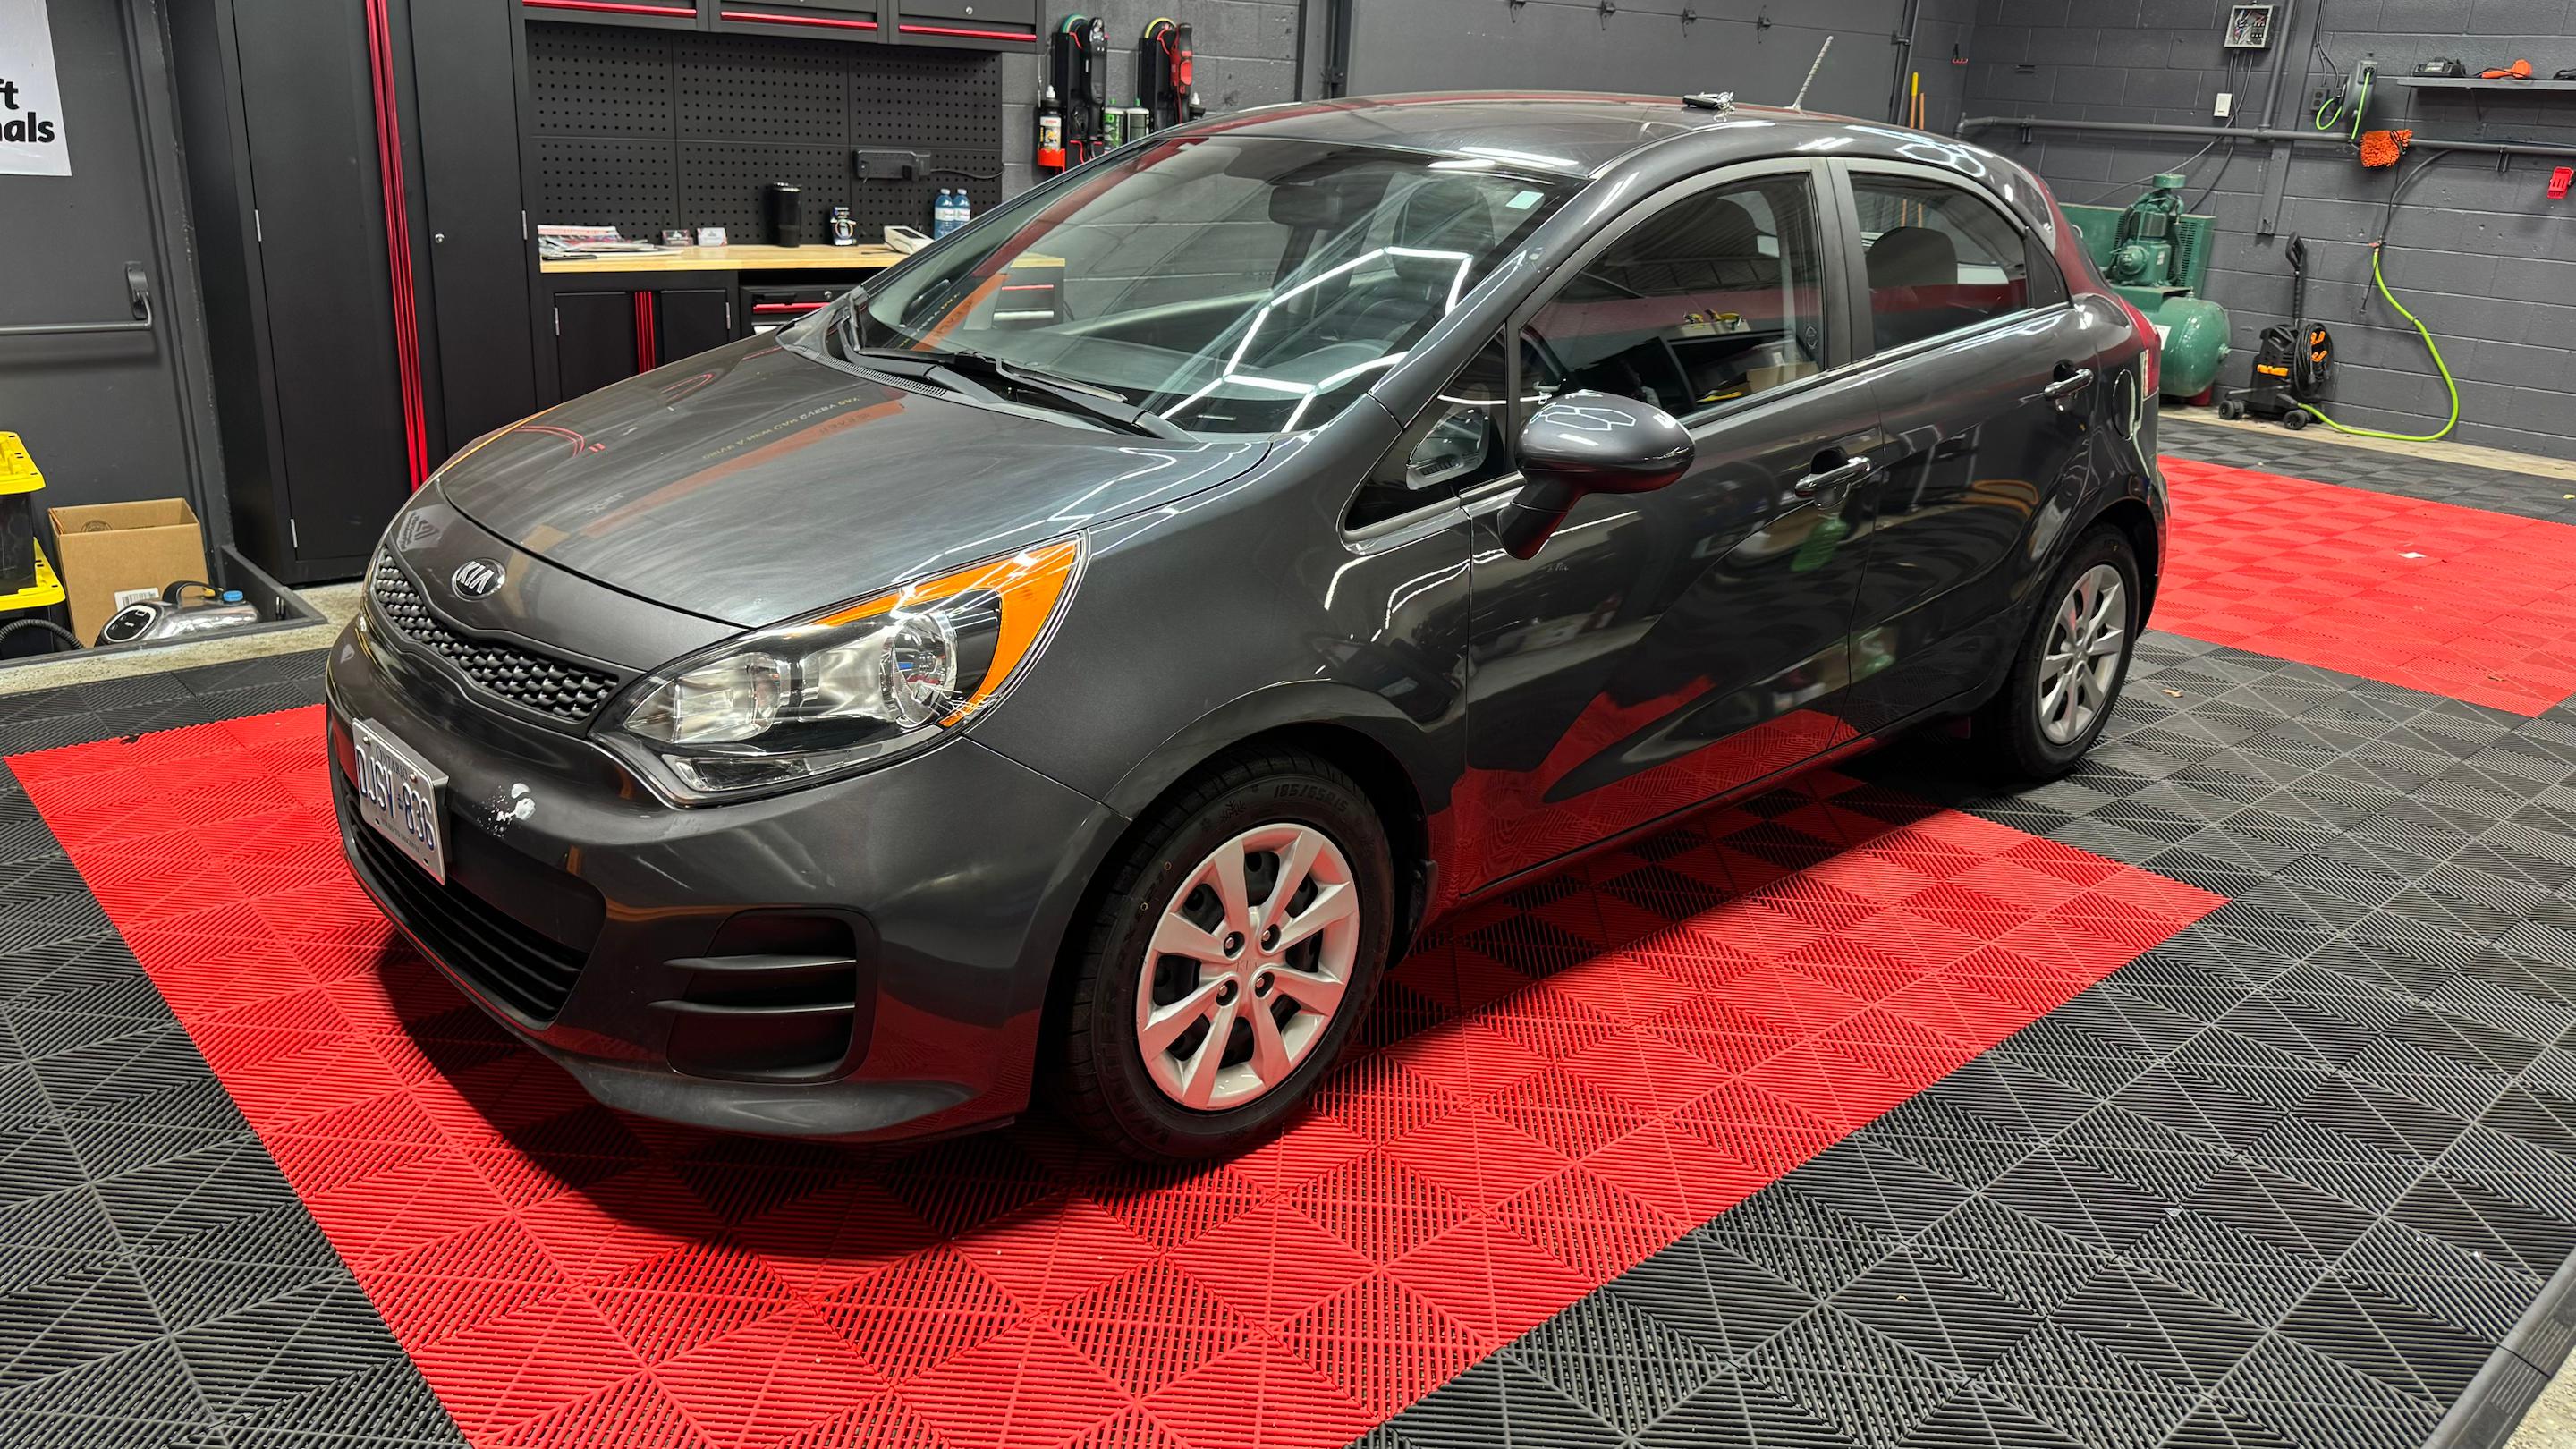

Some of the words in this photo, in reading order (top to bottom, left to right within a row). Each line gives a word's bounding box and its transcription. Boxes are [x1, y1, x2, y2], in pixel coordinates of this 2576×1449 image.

[0, 112, 55, 143] als
[456, 561, 495, 594] KIA
[375, 745, 408, 781] ONTARIO
[355, 744, 395, 819] DJSY
[402, 782, 435, 852] 836
